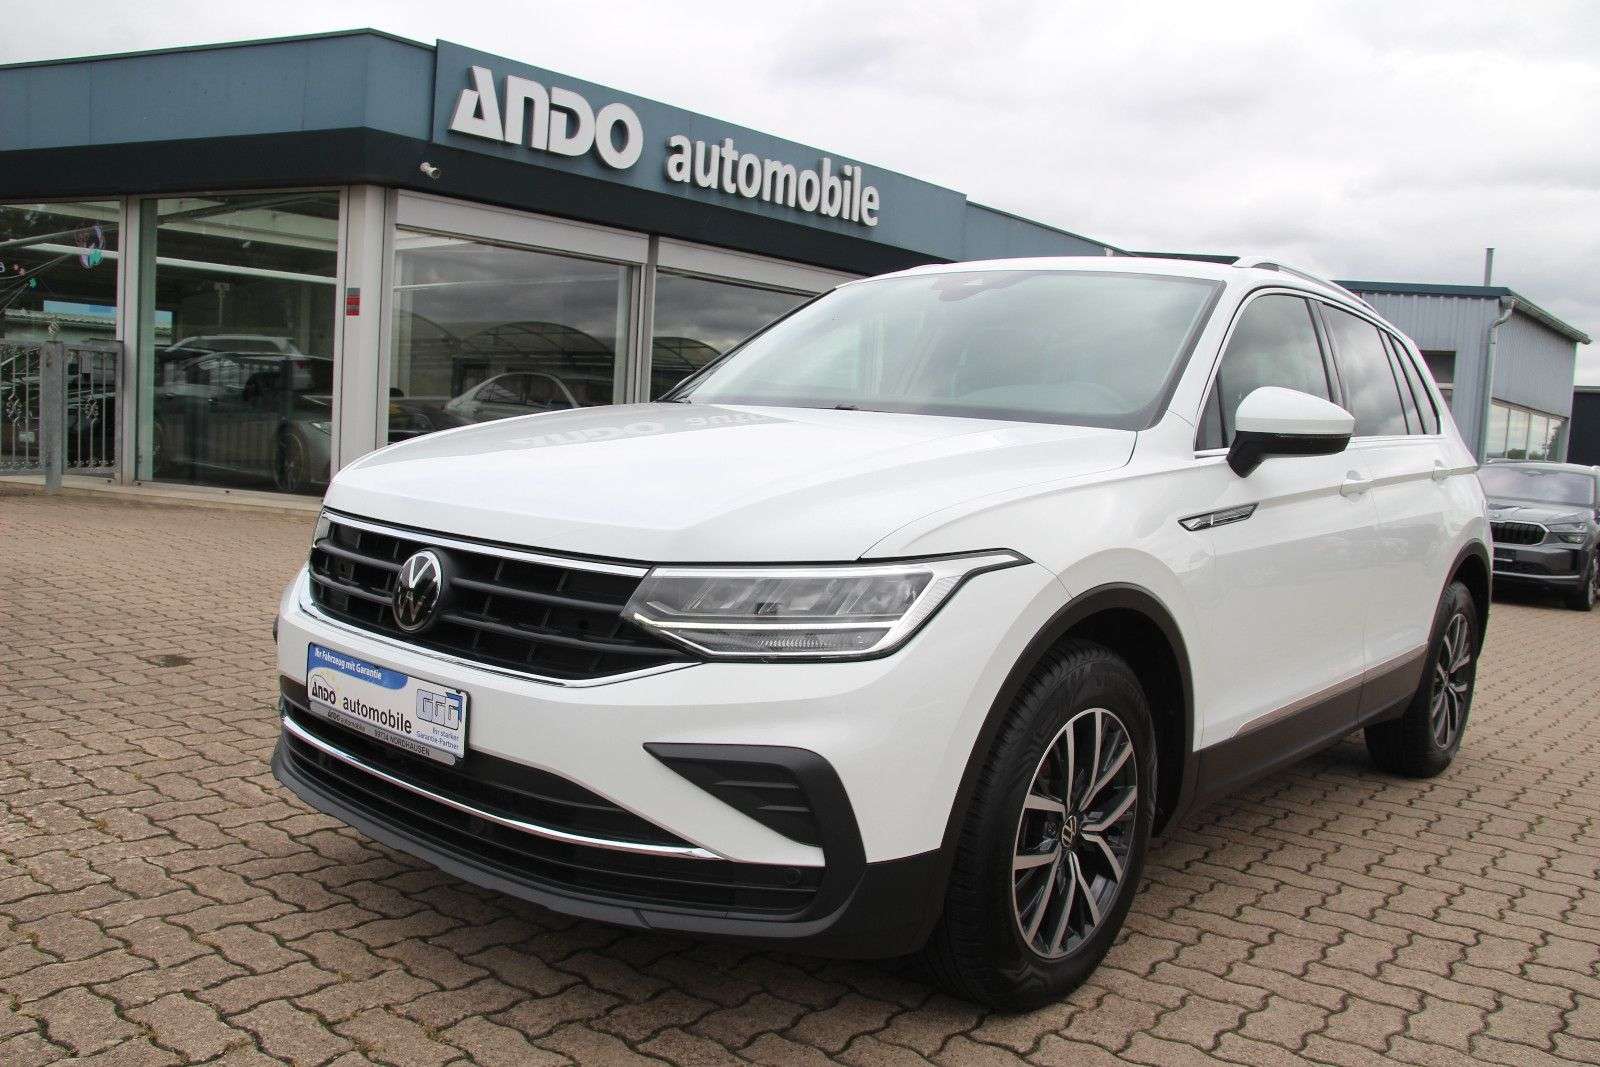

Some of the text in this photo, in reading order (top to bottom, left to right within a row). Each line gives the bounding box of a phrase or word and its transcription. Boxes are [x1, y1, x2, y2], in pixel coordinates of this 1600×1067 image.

[449, 65, 880, 227] ANDO automobile
[322, 650, 346, 669] Fahrzeug
[345, 660, 356, 671] mit
[356, 663, 382, 680] Garantie
[311, 682, 337, 705] ANDO
[342, 697, 413, 734] automobile
